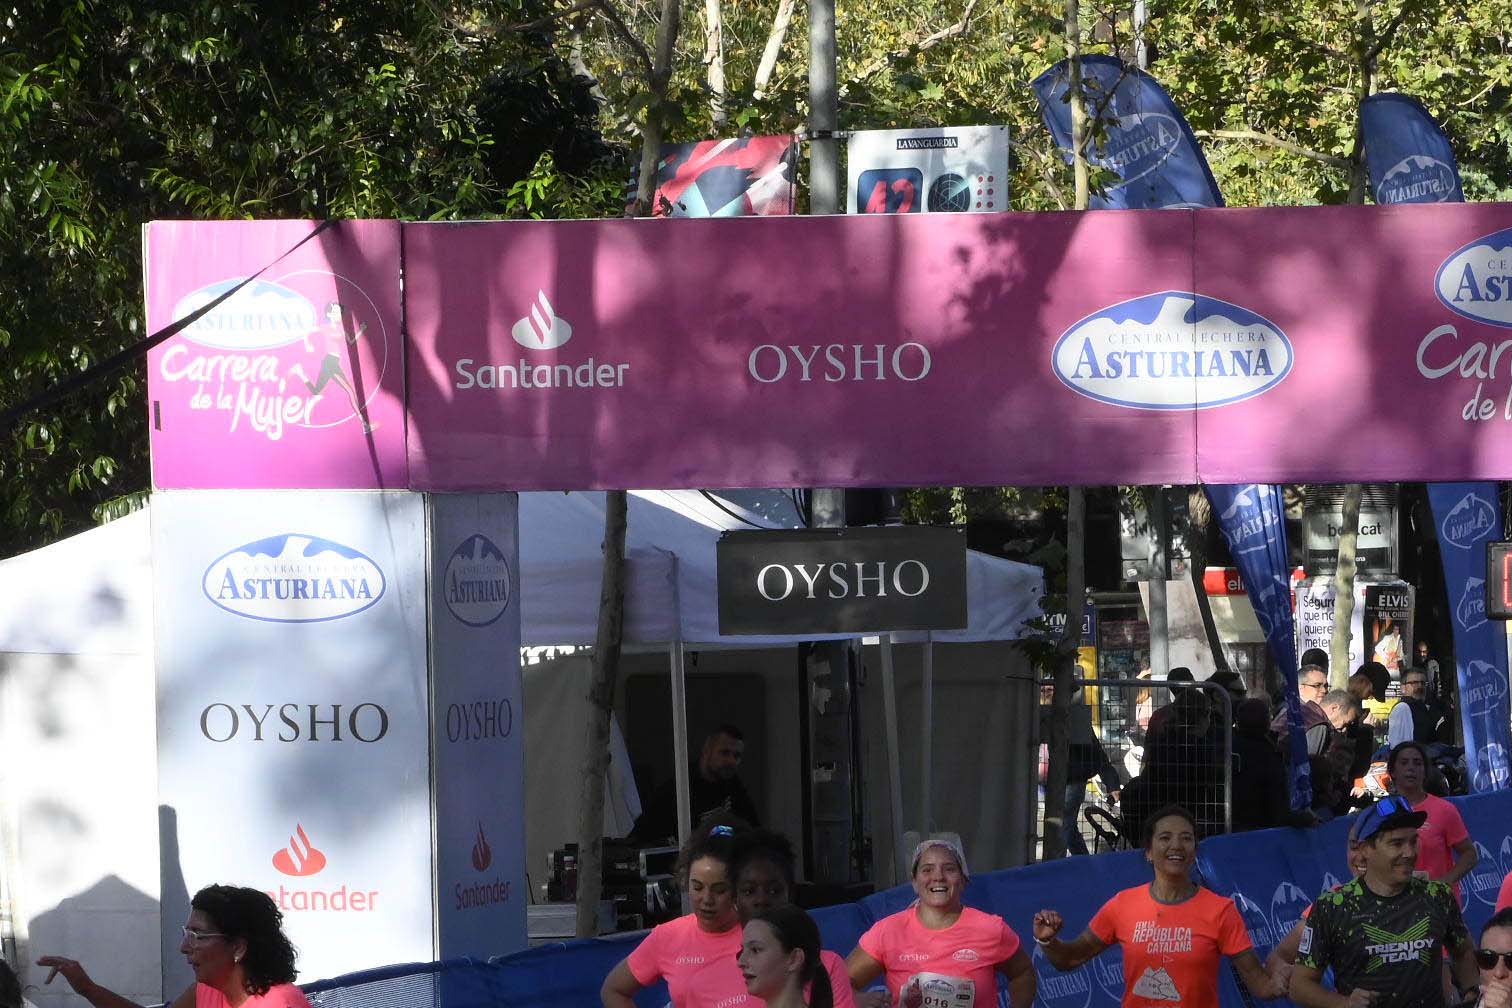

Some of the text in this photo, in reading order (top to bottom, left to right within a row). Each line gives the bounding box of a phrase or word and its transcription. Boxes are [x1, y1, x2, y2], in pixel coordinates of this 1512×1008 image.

[1108, 332, 1183, 345] CENTRAL
[160, 343, 279, 384] Carrera
[456, 356, 630, 389] Santander
[748, 342, 932, 384] OYSHO
[1072, 337, 1274, 380] ASTURIANA
[190, 378, 324, 441] de la Mujer
[1462, 385, 1497, 421] de
[217, 566, 373, 601] ASTURIANA
[757, 559, 930, 601] OYSHO
[1378, 594, 1409, 607] ELVIS
[1304, 625, 1335, 636] quiere
[199, 702, 390, 743] OYSHO
[446, 698, 513, 743] OYSHO
[455, 878, 511, 910] Santander
[1132, 924, 1193, 943] REPÚBLICA
[1147, 941, 1192, 954] CATALANA
[1365, 938, 1435, 956] TRIENJOY
[1380, 950, 1420, 964] TEAM
[924, 996, 949, 1008] 016
